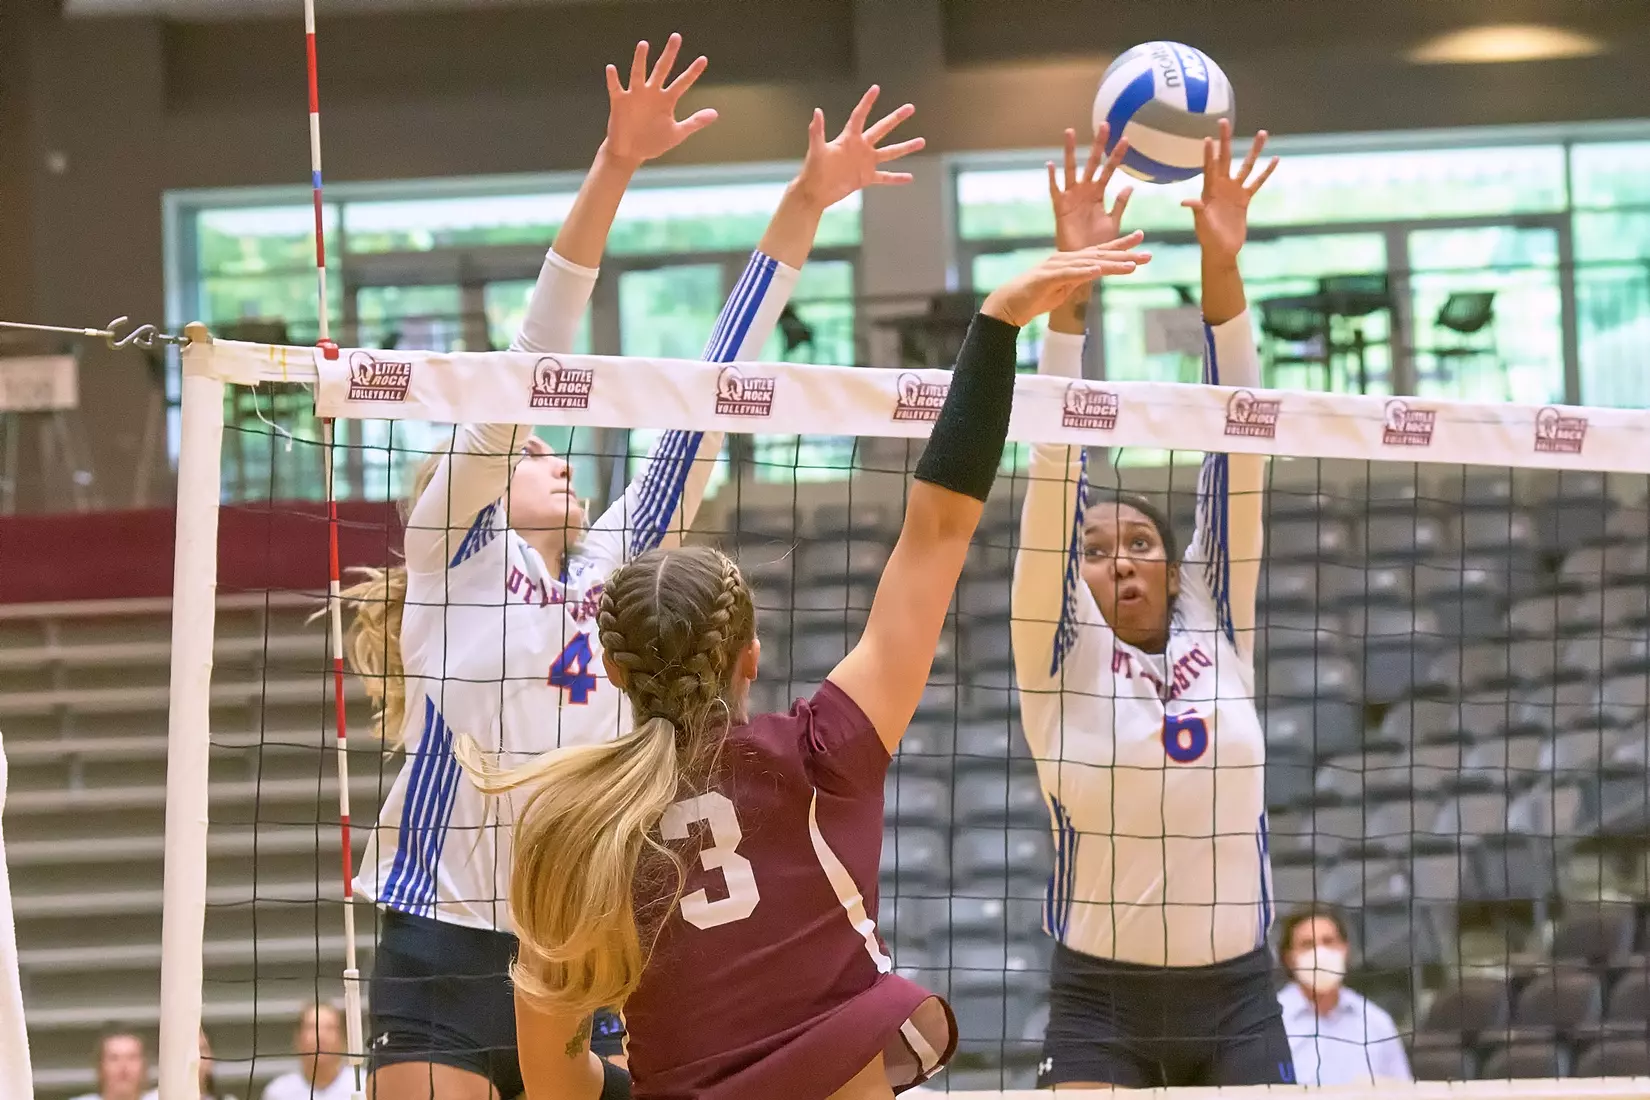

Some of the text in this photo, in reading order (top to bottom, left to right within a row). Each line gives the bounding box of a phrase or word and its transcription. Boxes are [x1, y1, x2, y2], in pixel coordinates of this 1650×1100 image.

[375, 364, 410, 375] LITTLE
[372, 376, 409, 386] ROCK
[560, 371, 592, 382] LITTLE
[557, 383, 590, 394] ROCK
[744, 380, 773, 391] LITTLE
[351, 390, 402, 400] VOLLEYBALL
[743, 391, 771, 401] ROCK
[532, 398, 586, 408] VOLLEYBALL
[717, 405, 768, 415] VOLLEYBALL
[896, 410, 939, 420] VOLLEYBA
[1086, 405, 1117, 415] ROCK
[547, 631, 597, 704] 4
[1162, 708, 1208, 763] 6
[659, 791, 760, 930] 3
